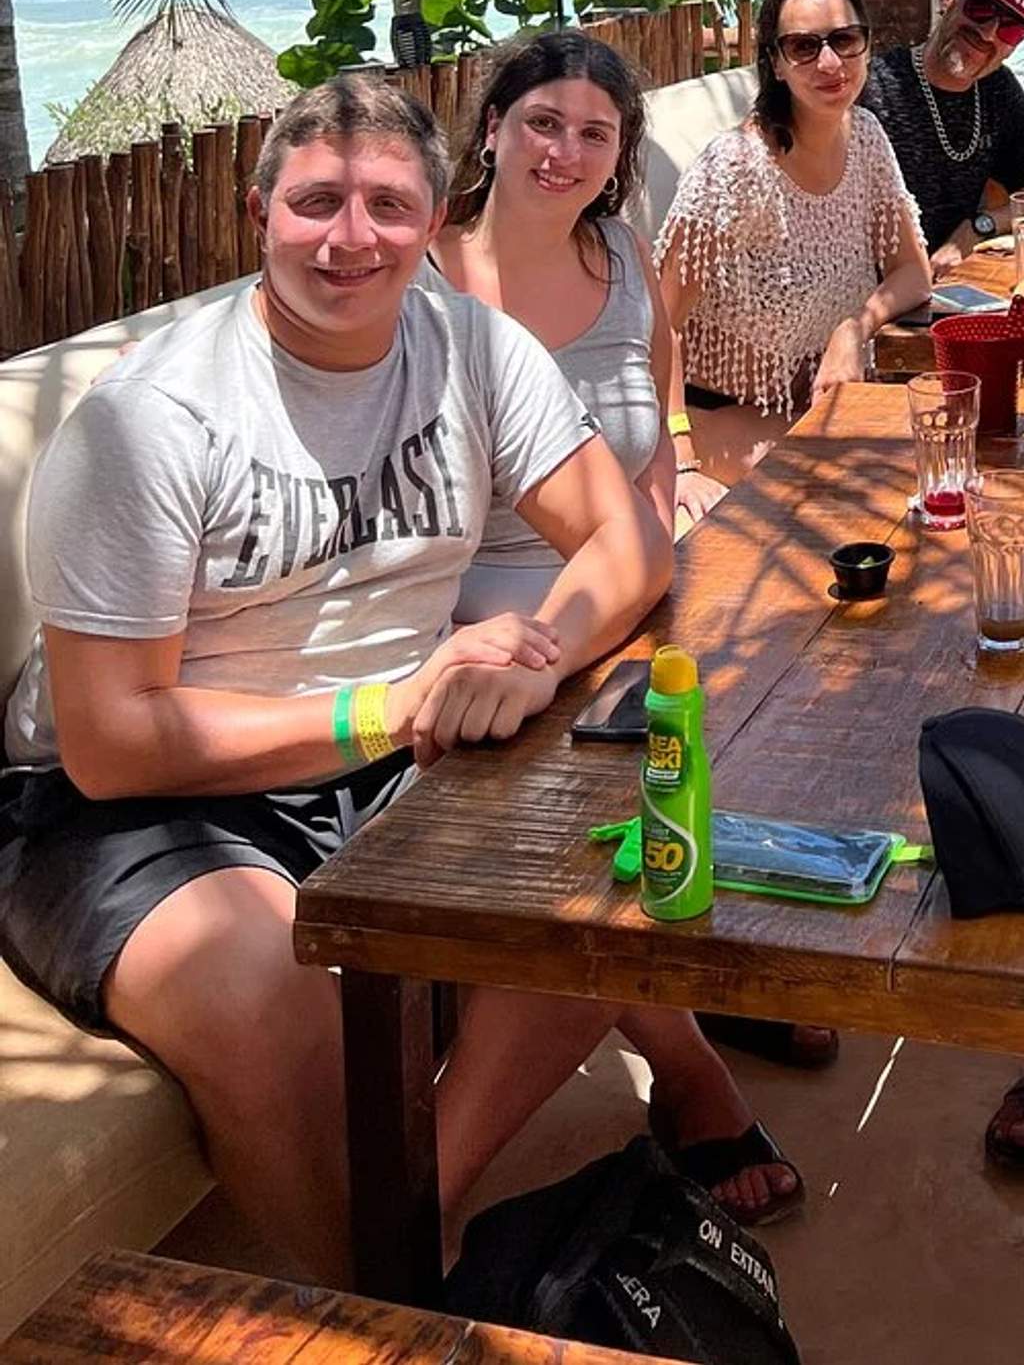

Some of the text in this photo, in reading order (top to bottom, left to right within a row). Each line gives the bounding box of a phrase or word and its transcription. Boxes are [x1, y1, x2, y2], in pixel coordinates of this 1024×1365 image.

[220, 414, 463, 588] EVERLAST
[645, 840, 684, 871] 50
[700, 1219, 722, 1249] ON
